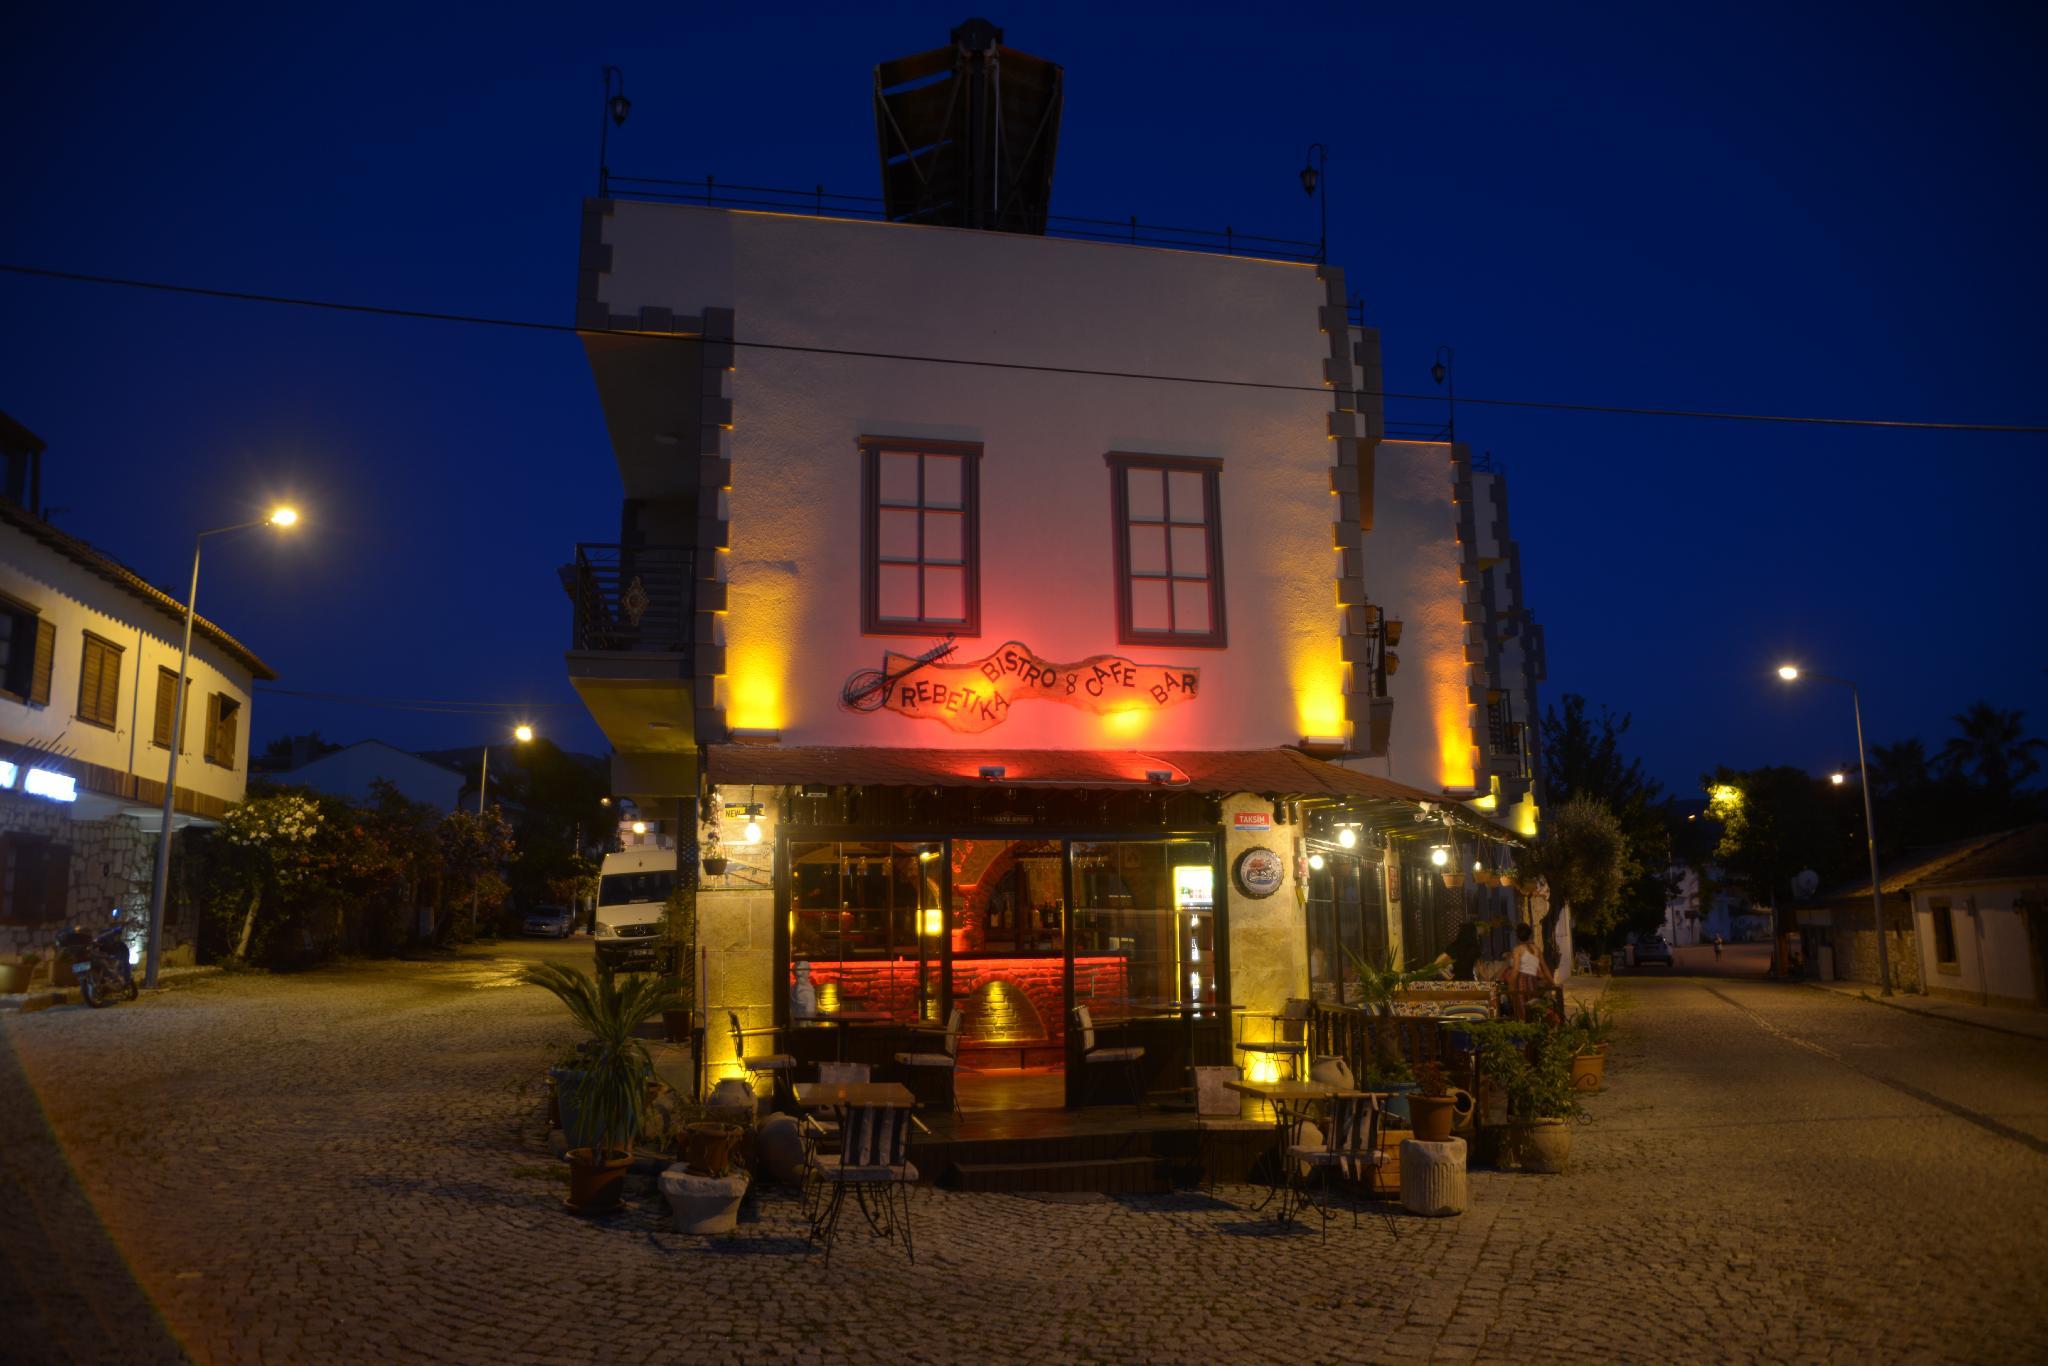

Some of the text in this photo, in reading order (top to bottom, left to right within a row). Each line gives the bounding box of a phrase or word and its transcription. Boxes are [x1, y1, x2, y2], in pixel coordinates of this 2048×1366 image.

[980, 651, 1057, 688] BISTRO
[1086, 661, 1137, 697] CAFE
[1150, 671, 1197, 704] BAR
[901, 681, 1012, 721] REBETIKA
